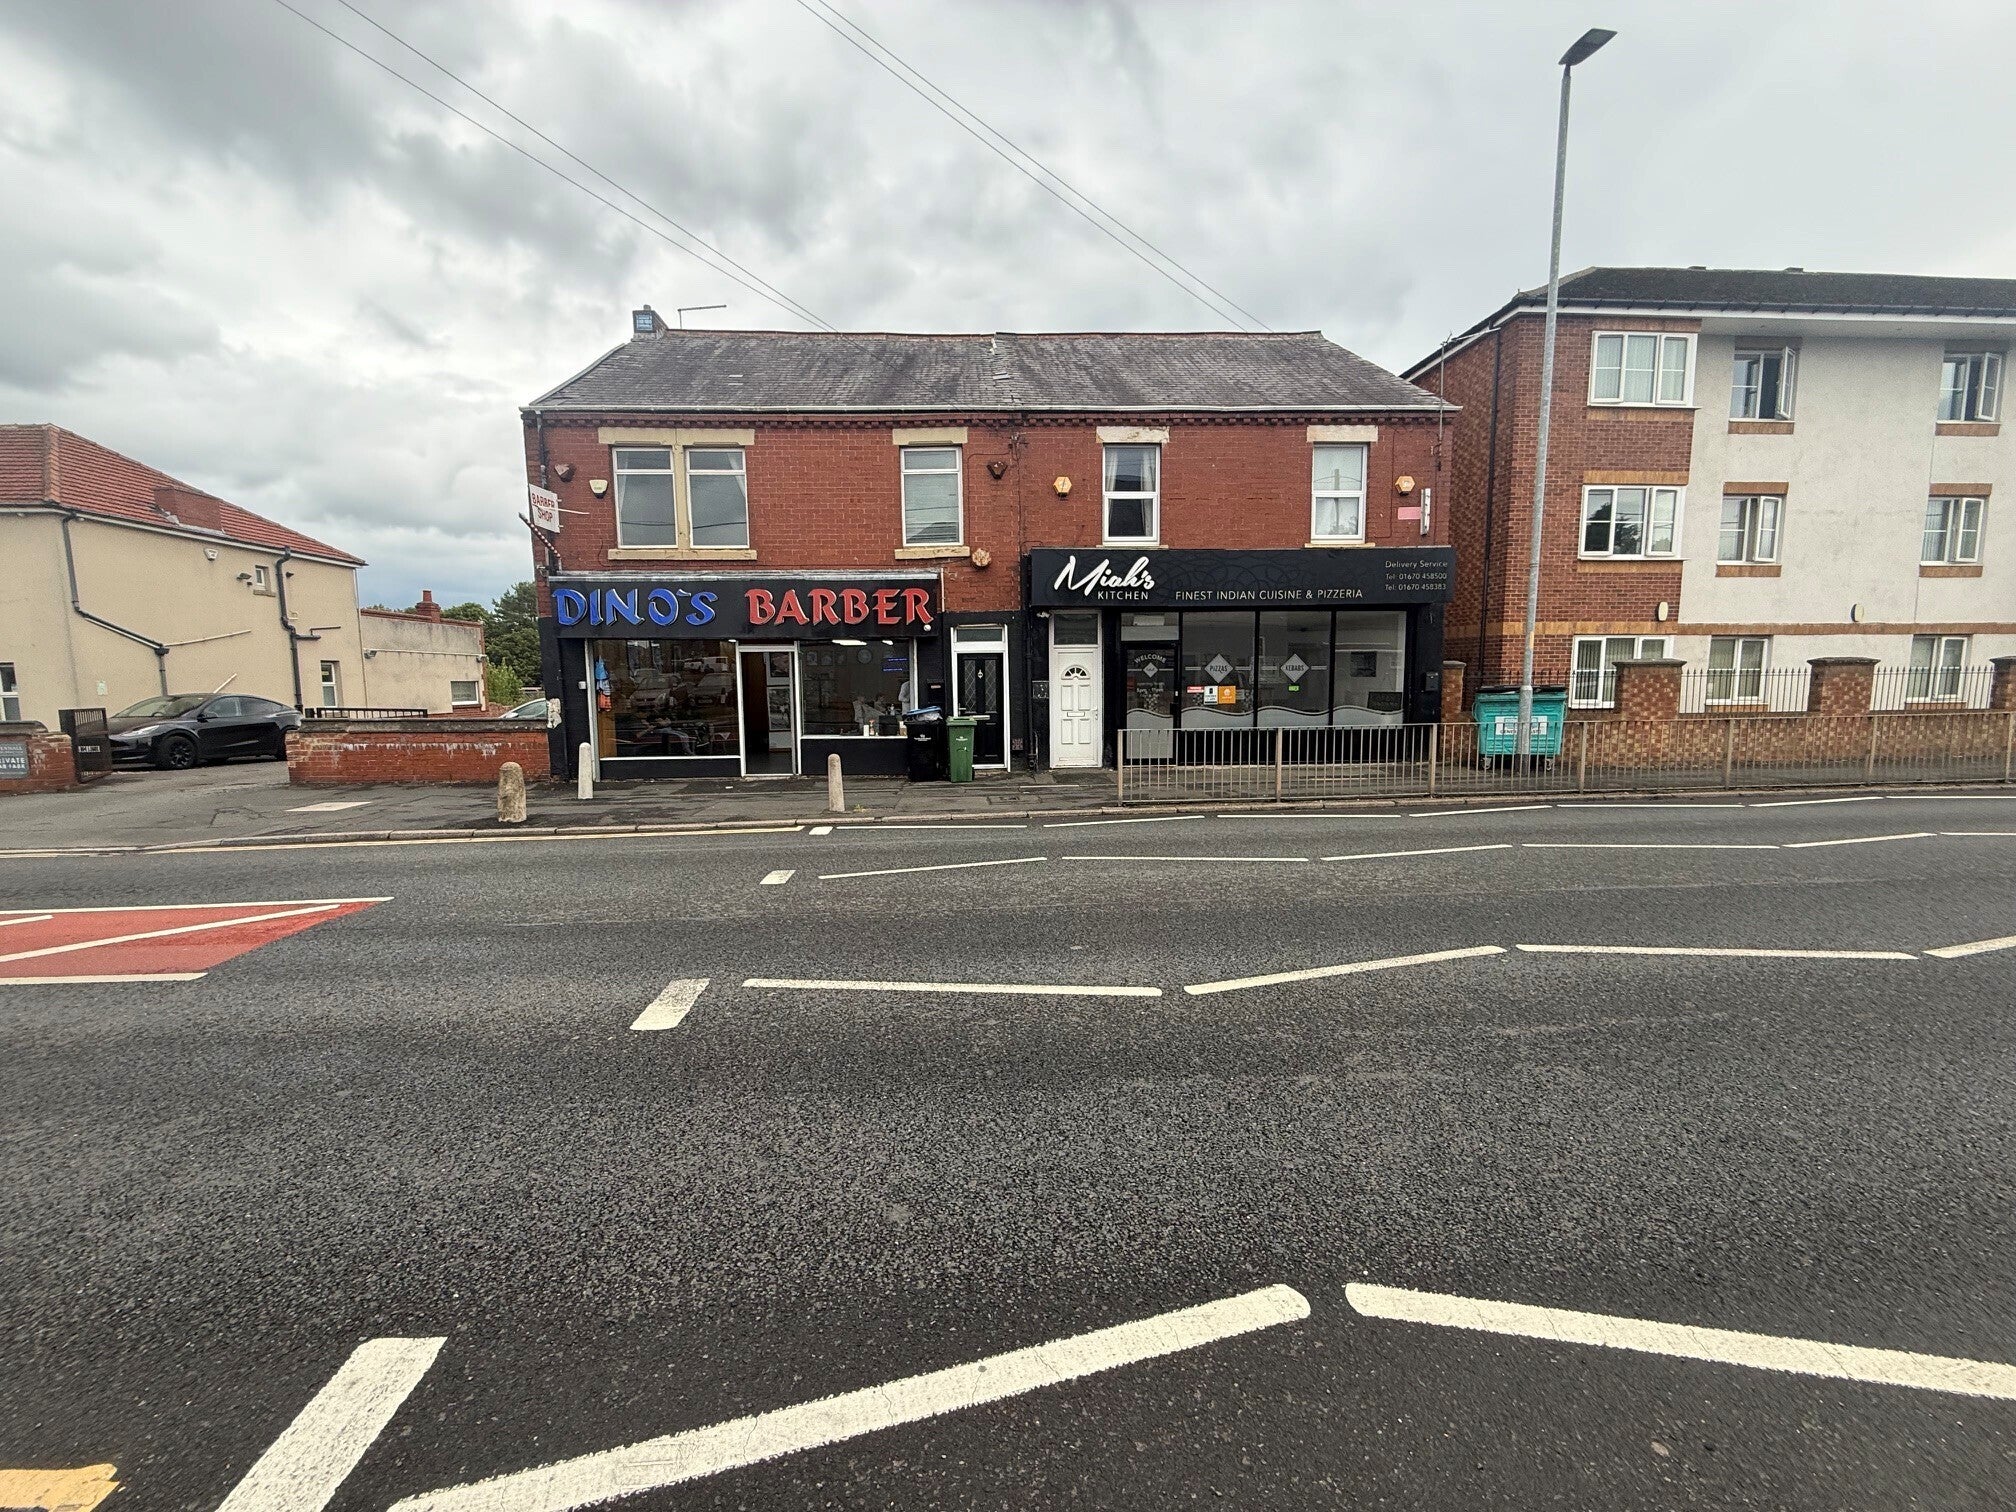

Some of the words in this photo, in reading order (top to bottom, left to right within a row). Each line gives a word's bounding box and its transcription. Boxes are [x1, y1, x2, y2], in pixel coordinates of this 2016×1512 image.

[531, 492, 555, 508] BARBER
[537, 510, 553, 523] SHOP
[1385, 560, 1418, 569] Delivery
[1419, 560, 1448, 568] Service
[1053, 555, 1155, 597] Miah's
[1421, 572, 1447, 580] 458500
[1398, 583, 1420, 591] 01670
[1097, 591, 1149, 600] KITCHEN
[1175, 591, 1213, 601] FINEST
[1216, 590, 1255, 600] INDIAN
[1259, 590, 1302, 600] CUISINE
[1305, 590, 1313, 599] &
[1317, 589, 1363, 599] PIZZERIA
[551, 588, 719, 626] DINO'S
[744, 587, 935, 626] BARBER
[1134, 653, 1167, 664] WELCOME
[1209, 665, 1228, 674] PIZZAS
